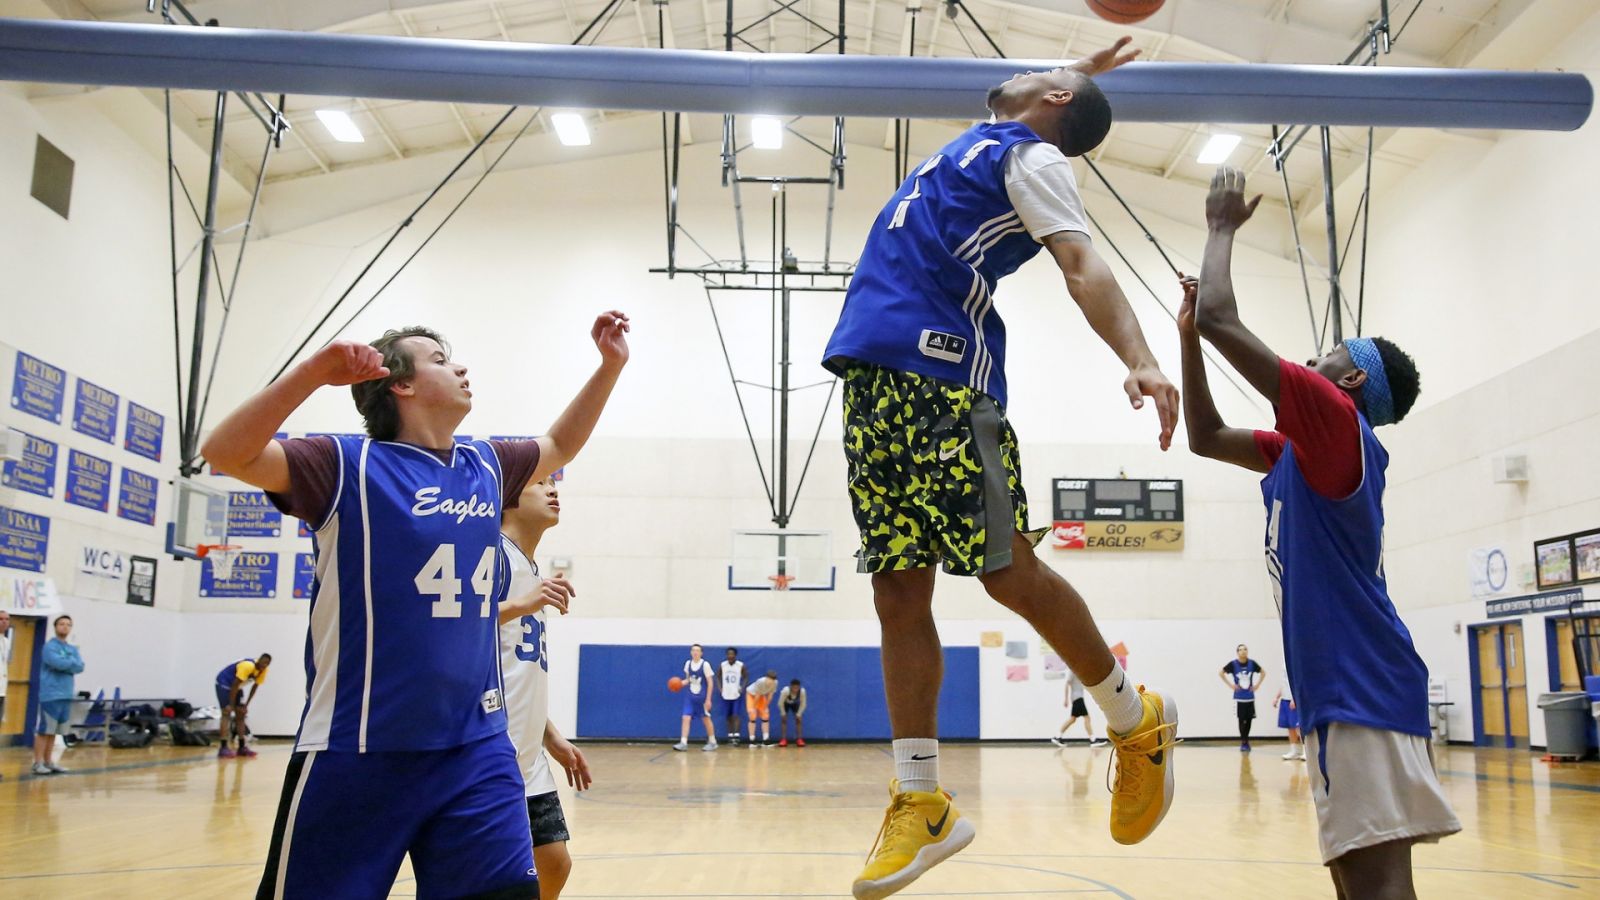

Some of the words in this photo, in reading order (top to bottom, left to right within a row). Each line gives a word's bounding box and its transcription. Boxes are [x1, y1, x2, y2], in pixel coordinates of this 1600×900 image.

[22, 356, 62, 385] METRO
[82, 383, 116, 408] METRO
[132, 404, 161, 428] METRO
[23, 438, 54, 458] ETRO
[74, 452, 108, 476] METRO
[1057, 480, 1089, 489] GUEST
[1148, 481, 1177, 490] HOME
[230, 493, 269, 507] ISAA
[411, 486, 496, 524] Eagles
[7, 510, 42, 533] VISAA
[1105, 524, 1127, 535] GO
[1086, 536, 1146, 548] EAGLES!
[84, 546, 123, 574] WCA
[239, 554, 271, 567] TRO
[413, 543, 496, 618] 44
[724, 675, 737, 684] 40
